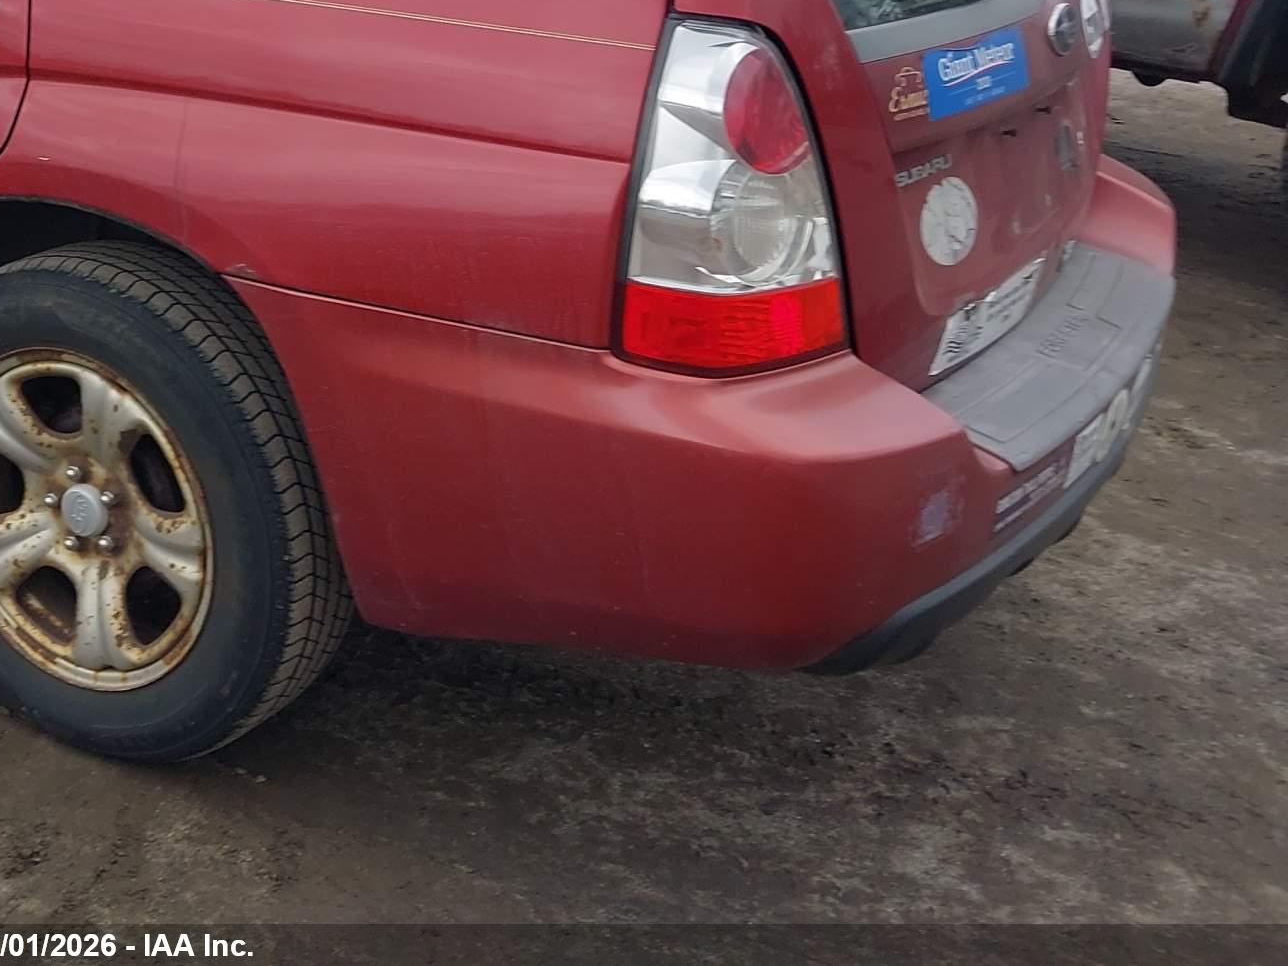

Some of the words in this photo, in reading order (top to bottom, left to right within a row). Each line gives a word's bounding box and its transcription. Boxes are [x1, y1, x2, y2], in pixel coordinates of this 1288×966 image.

[938, 51, 974, 82] Giant
[973, 42, 1015, 70] Meteor
[893, 154, 953, 188] SUBARU
